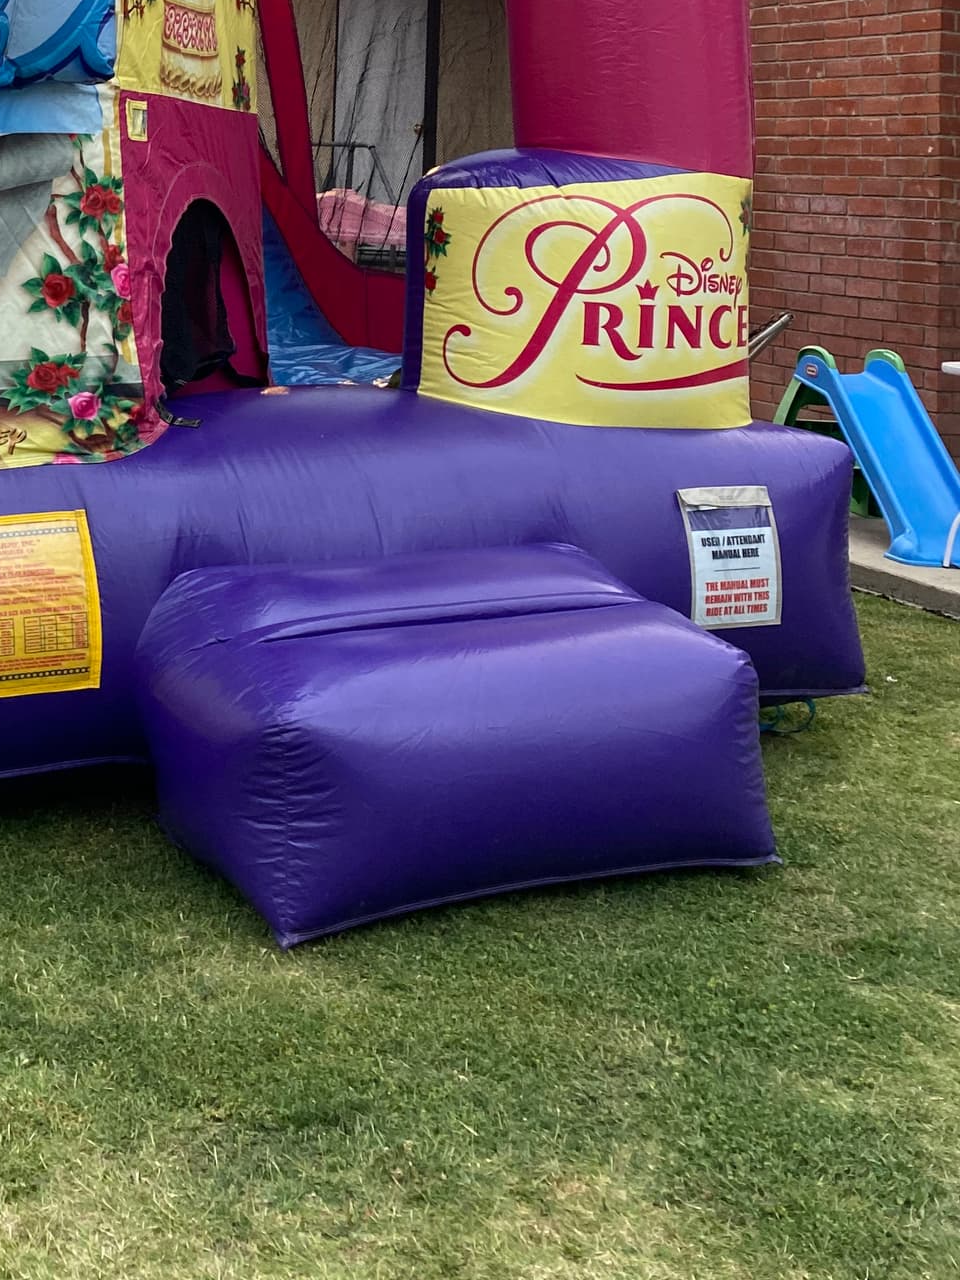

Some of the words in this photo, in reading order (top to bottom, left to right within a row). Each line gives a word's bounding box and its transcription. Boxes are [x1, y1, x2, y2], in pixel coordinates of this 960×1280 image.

[726, 534, 766, 546] ATTENDANT
[712, 549, 741, 560] MANUAL
[742, 548, 760, 558] HERE
[705, 582, 719, 592] THE
[720, 580, 748, 590] MANUAL
[749, 578, 769, 588] MUST
[705, 593, 733, 604] REMAIN
[733, 592, 753, 602] WITH
[754, 591, 770, 601] THIS
[706, 607, 722, 616] RIDE
[724, 606, 733, 615] AT
[733, 605, 745, 614] ALL
[746, 604, 768, 614] TIMES
